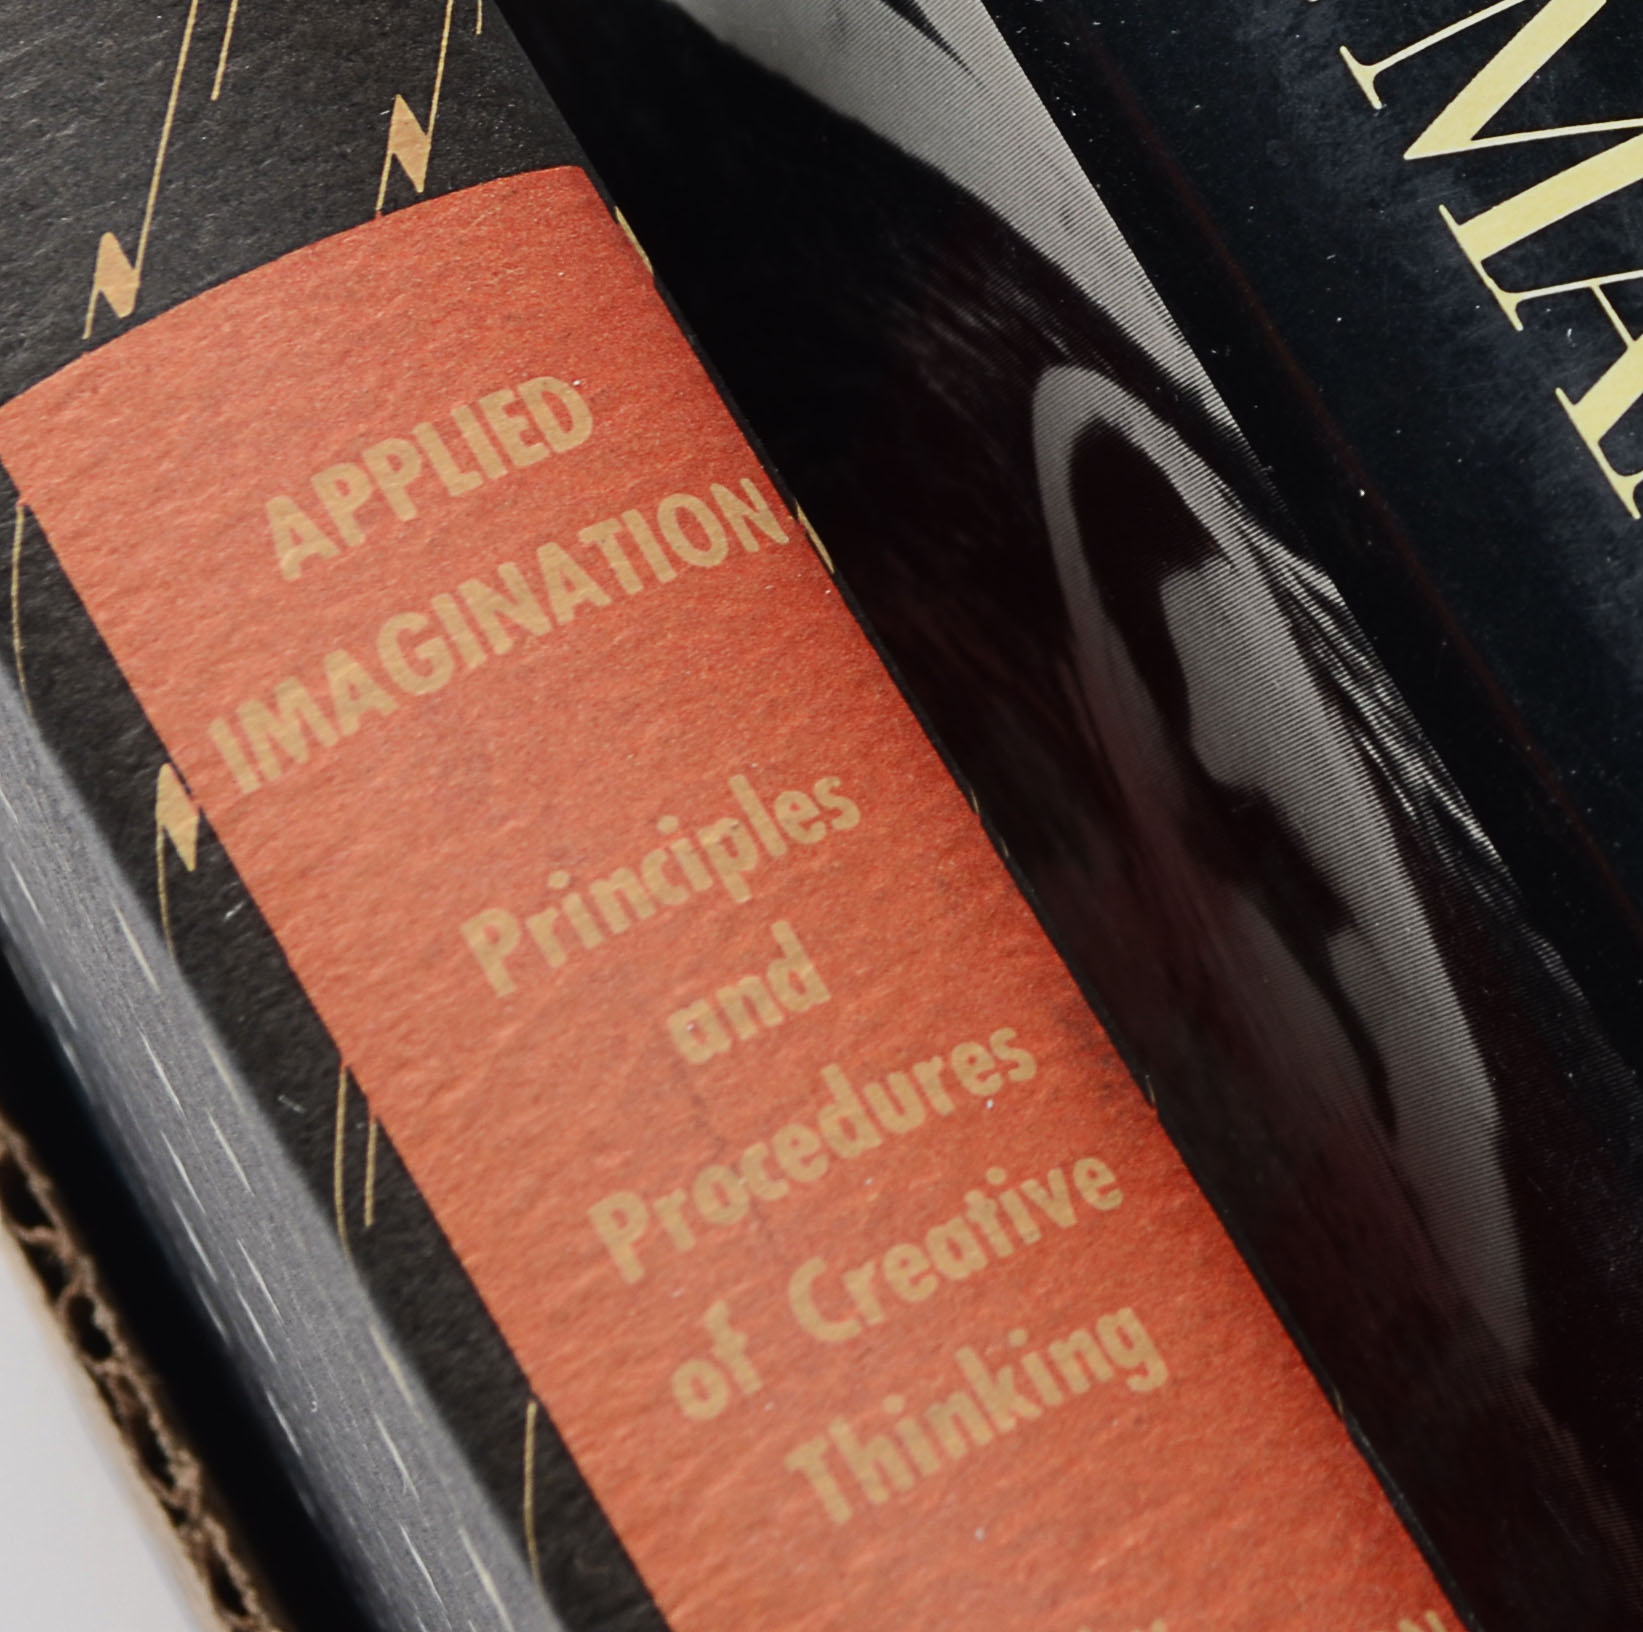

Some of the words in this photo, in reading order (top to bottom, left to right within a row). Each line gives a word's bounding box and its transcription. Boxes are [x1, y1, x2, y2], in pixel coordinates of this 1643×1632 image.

[264, 374, 595, 581] APPLIED
[207, 476, 791, 796] IMAGINATION
[459, 772, 862, 998] Principles
[666, 919, 832, 1066] and
[585, 1026, 1038, 1285] Procedures
[671, 1298, 765, 1423] of
[787, 1155, 1126, 1344] Creative
[783, 1306, 1169, 1526] Thinking
